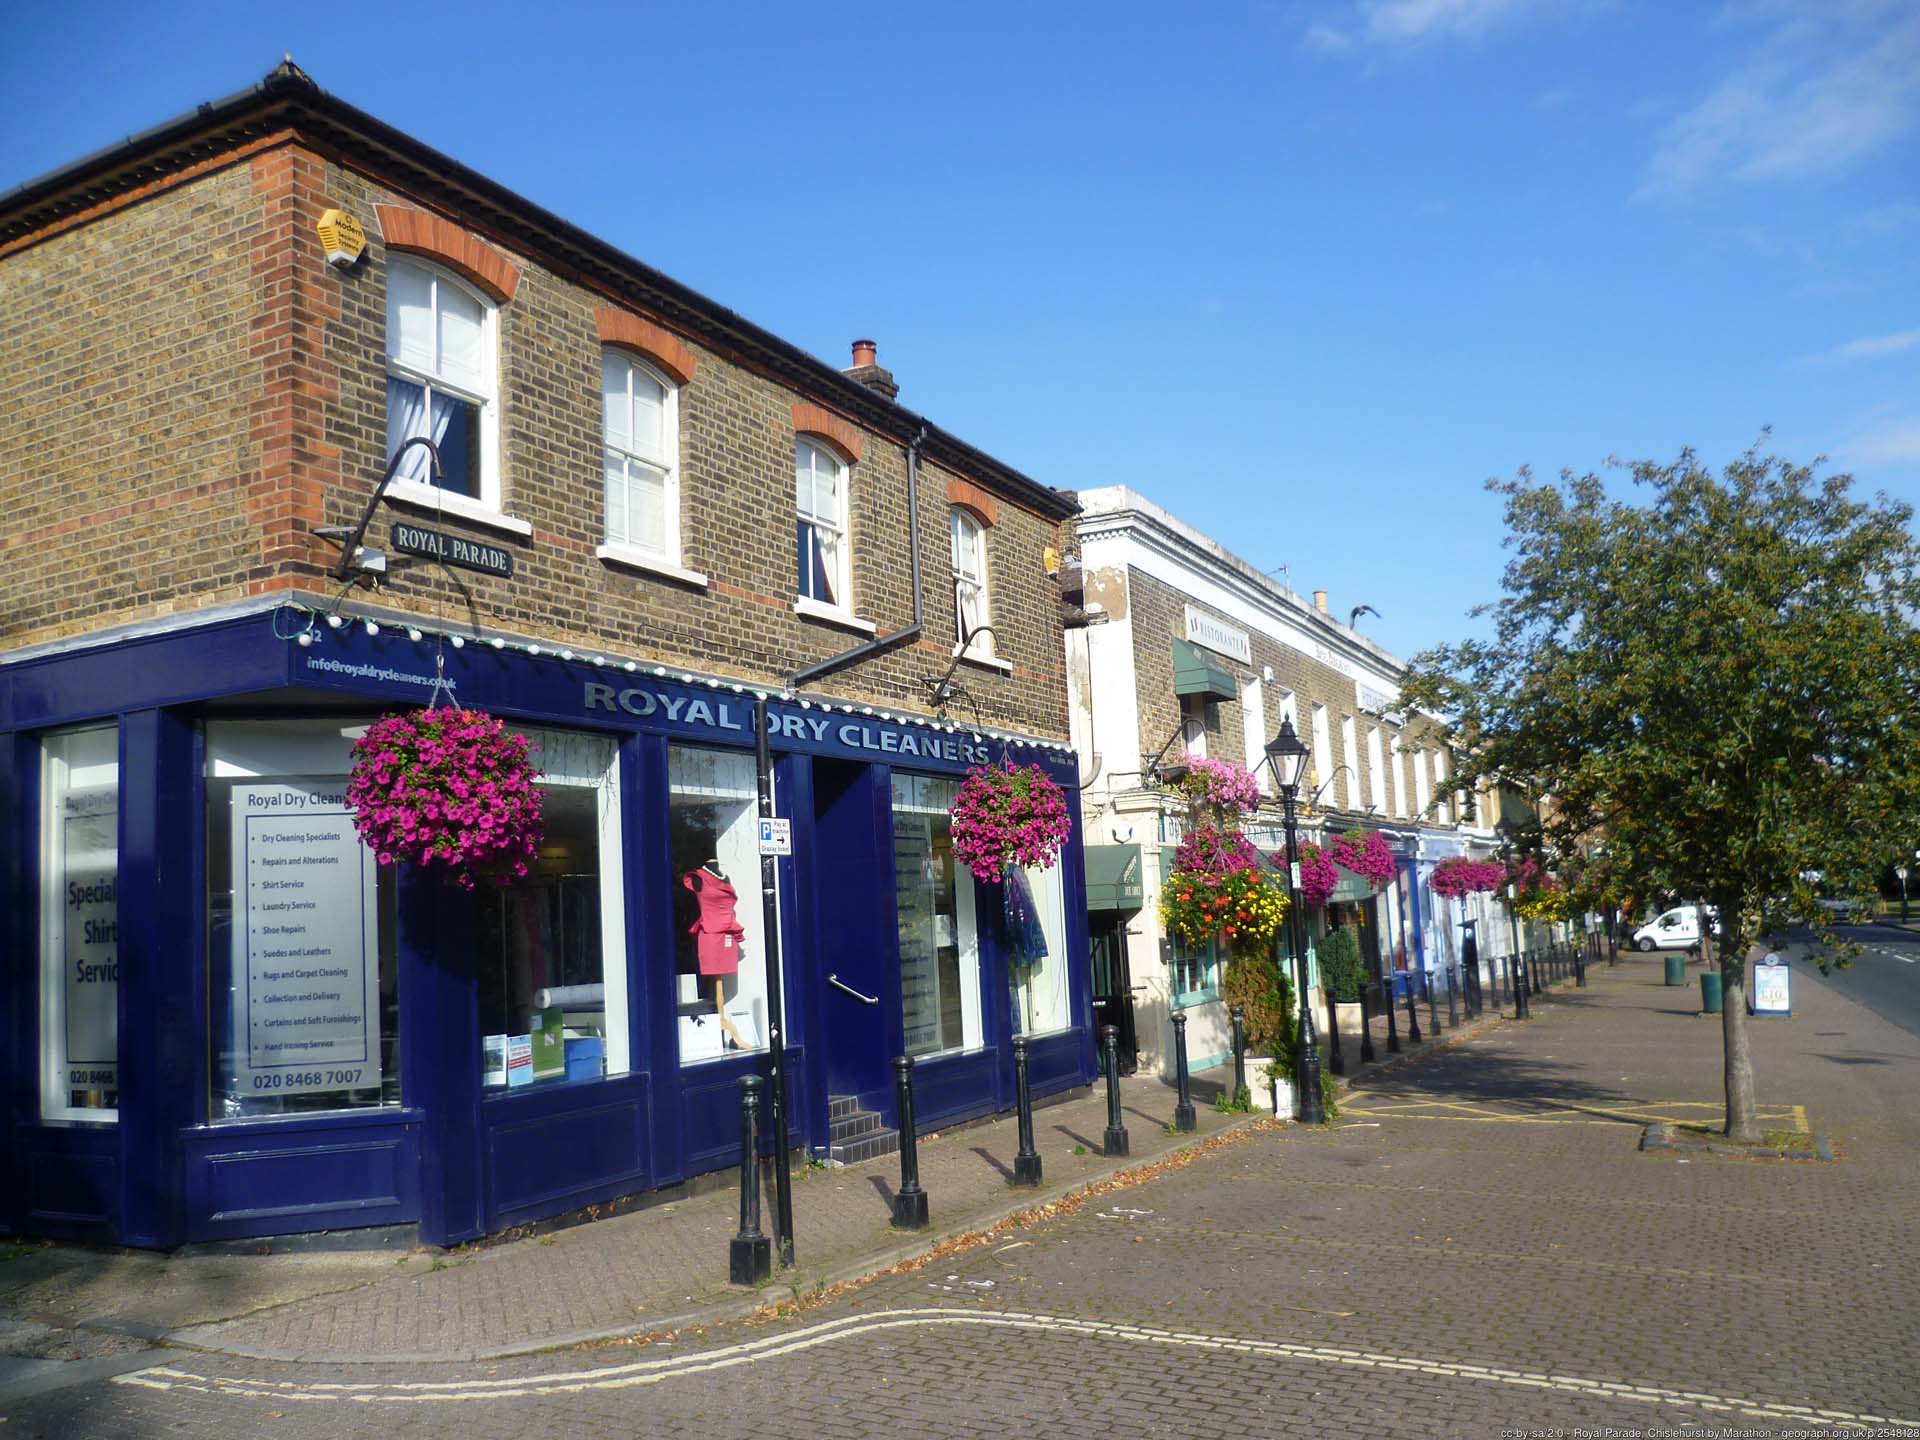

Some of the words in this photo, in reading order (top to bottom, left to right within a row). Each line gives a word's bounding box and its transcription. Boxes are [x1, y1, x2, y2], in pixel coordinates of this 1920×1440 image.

[336, 218, 362, 238] Modern
[398, 527, 448, 556] ROYAL
[452, 540, 507, 571] PARADE
[583, 681, 741, 731] ROYAL
[752, 709, 830, 742] DRY
[839, 724, 990, 766] CLEANERS
[248, 793, 282, 808] Royal
[285, 793, 306, 808] Dry
[262, 834, 275, 844] Dry
[276, 834, 305, 843] Cleaning
[306, 832, 341, 842] Specialists
[763, 823, 770, 840] P
[262, 858, 288, 868] Repairs
[288, 857, 302, 865] and
[302, 856, 339, 864] Alterations
[262, 881, 280, 889] Shirt
[280, 880, 304, 888] Service
[68, 878, 117, 912] Special
[262, 902, 291, 912] Laundry
[291, 902, 316, 910] Service
[84, 919, 118, 944] Shirt
[263, 926, 280, 935] Shoe
[281, 926, 306, 936] Repairs
[263, 950, 288, 958] Suedes
[288, 949, 302, 957] and
[302, 948, 332, 956] Leathers
[76, 957, 118, 983] Servic
[264, 971, 280, 982] Rugs
[281, 970, 294, 978] and
[295, 970, 318, 980] Carpet
[319, 968, 348, 978] Cleaning
[264, 994, 298, 1004] Collection
[299, 993, 312, 1002] and
[312, 992, 340, 1002] Delivery
[264, 1018, 292, 1028] Curtains
[293, 1018, 307, 1026] and
[308, 1016, 322, 1025] Soft
[322, 1014, 362, 1024] Furnishings
[264, 1042, 283, 1050] Hand
[309, 1040, 334, 1049] Service
[70, 1070, 88, 1084] 020
[254, 1074, 282, 1089] 020
[286, 1072, 322, 1087] 8468
[326, 1069, 362, 1084] 7007
